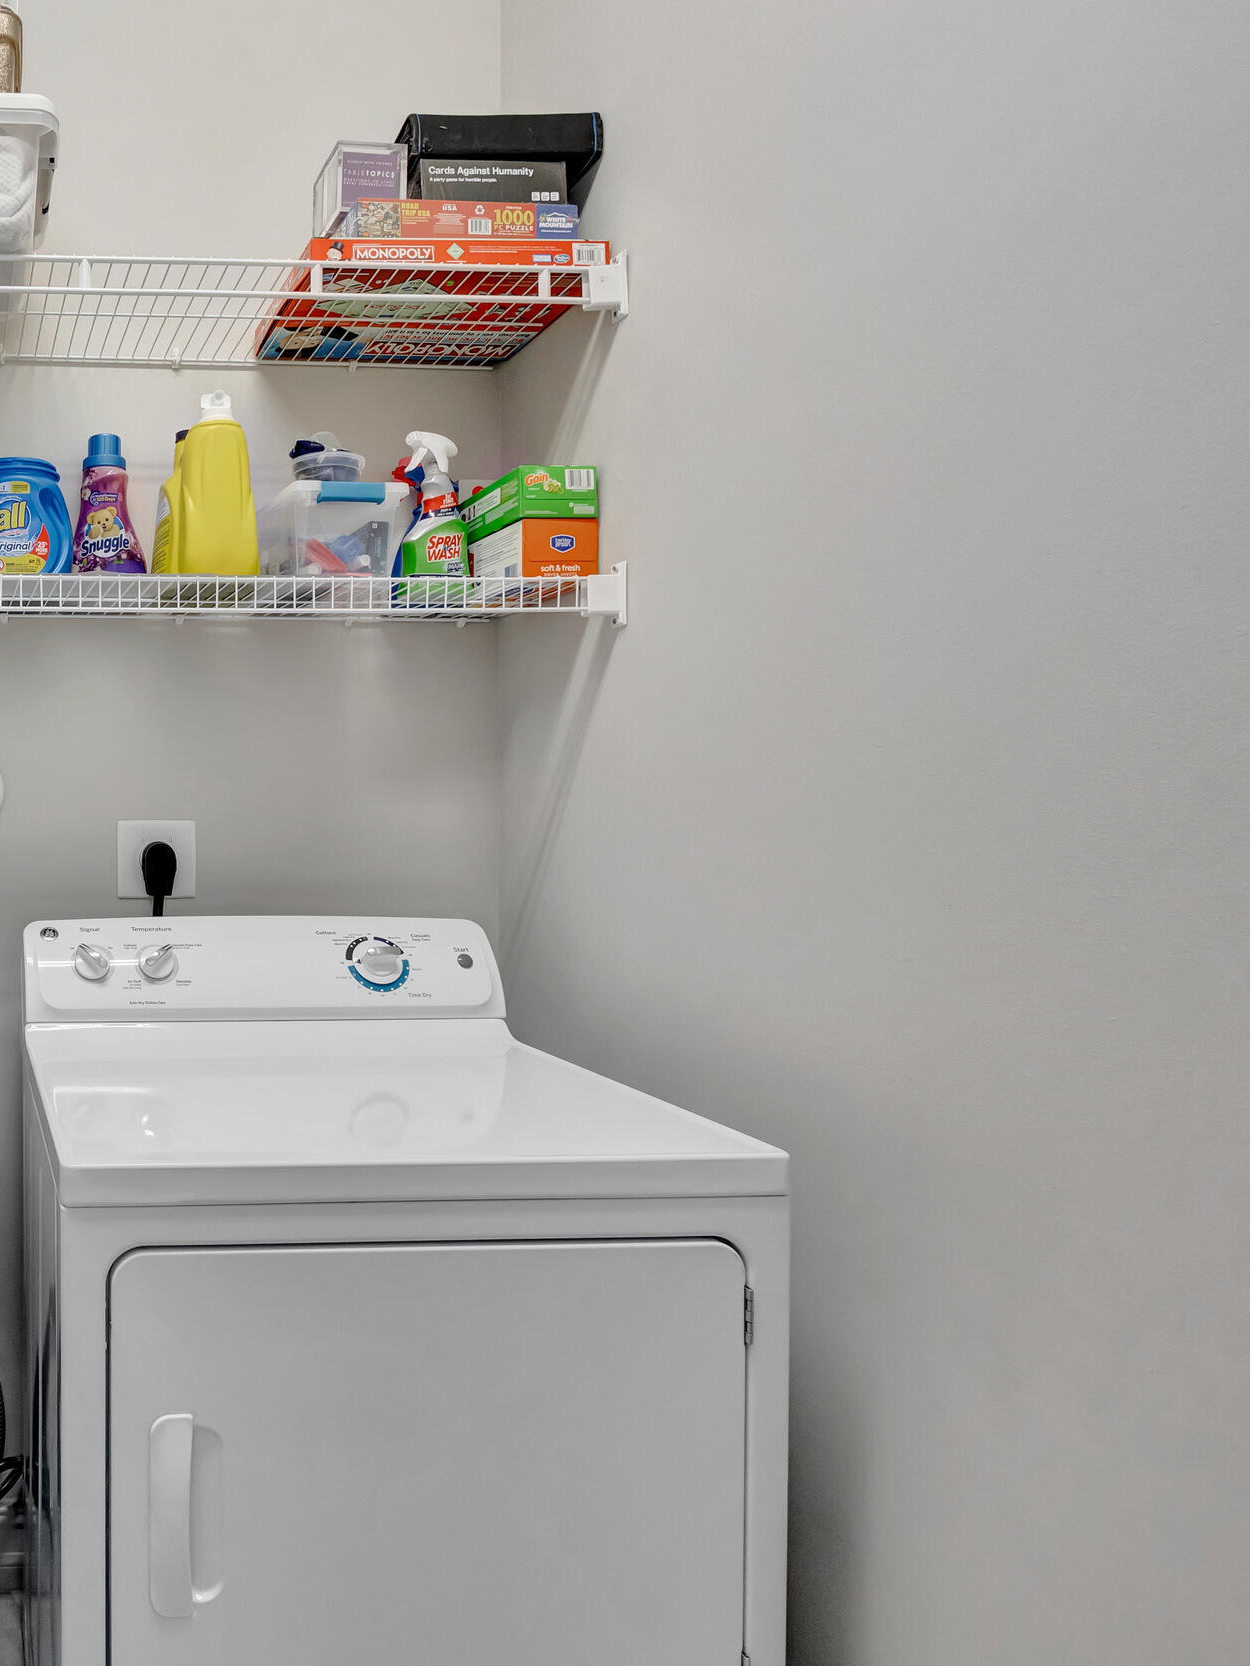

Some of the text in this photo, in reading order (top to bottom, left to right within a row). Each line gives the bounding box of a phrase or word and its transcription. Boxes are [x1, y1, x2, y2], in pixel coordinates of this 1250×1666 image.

[428, 166, 534, 177] Cards Against Humanity
[494, 209, 534, 226] 1000
[356, 247, 432, 260] MONOPOLY
[366, 342, 513, 356] MONOPOLY
[525, 472, 549, 486] Gain
[81, 534, 130, 557] Snuggle
[428, 534, 463, 549] SPRAY
[428, 547, 460, 562] WASH
